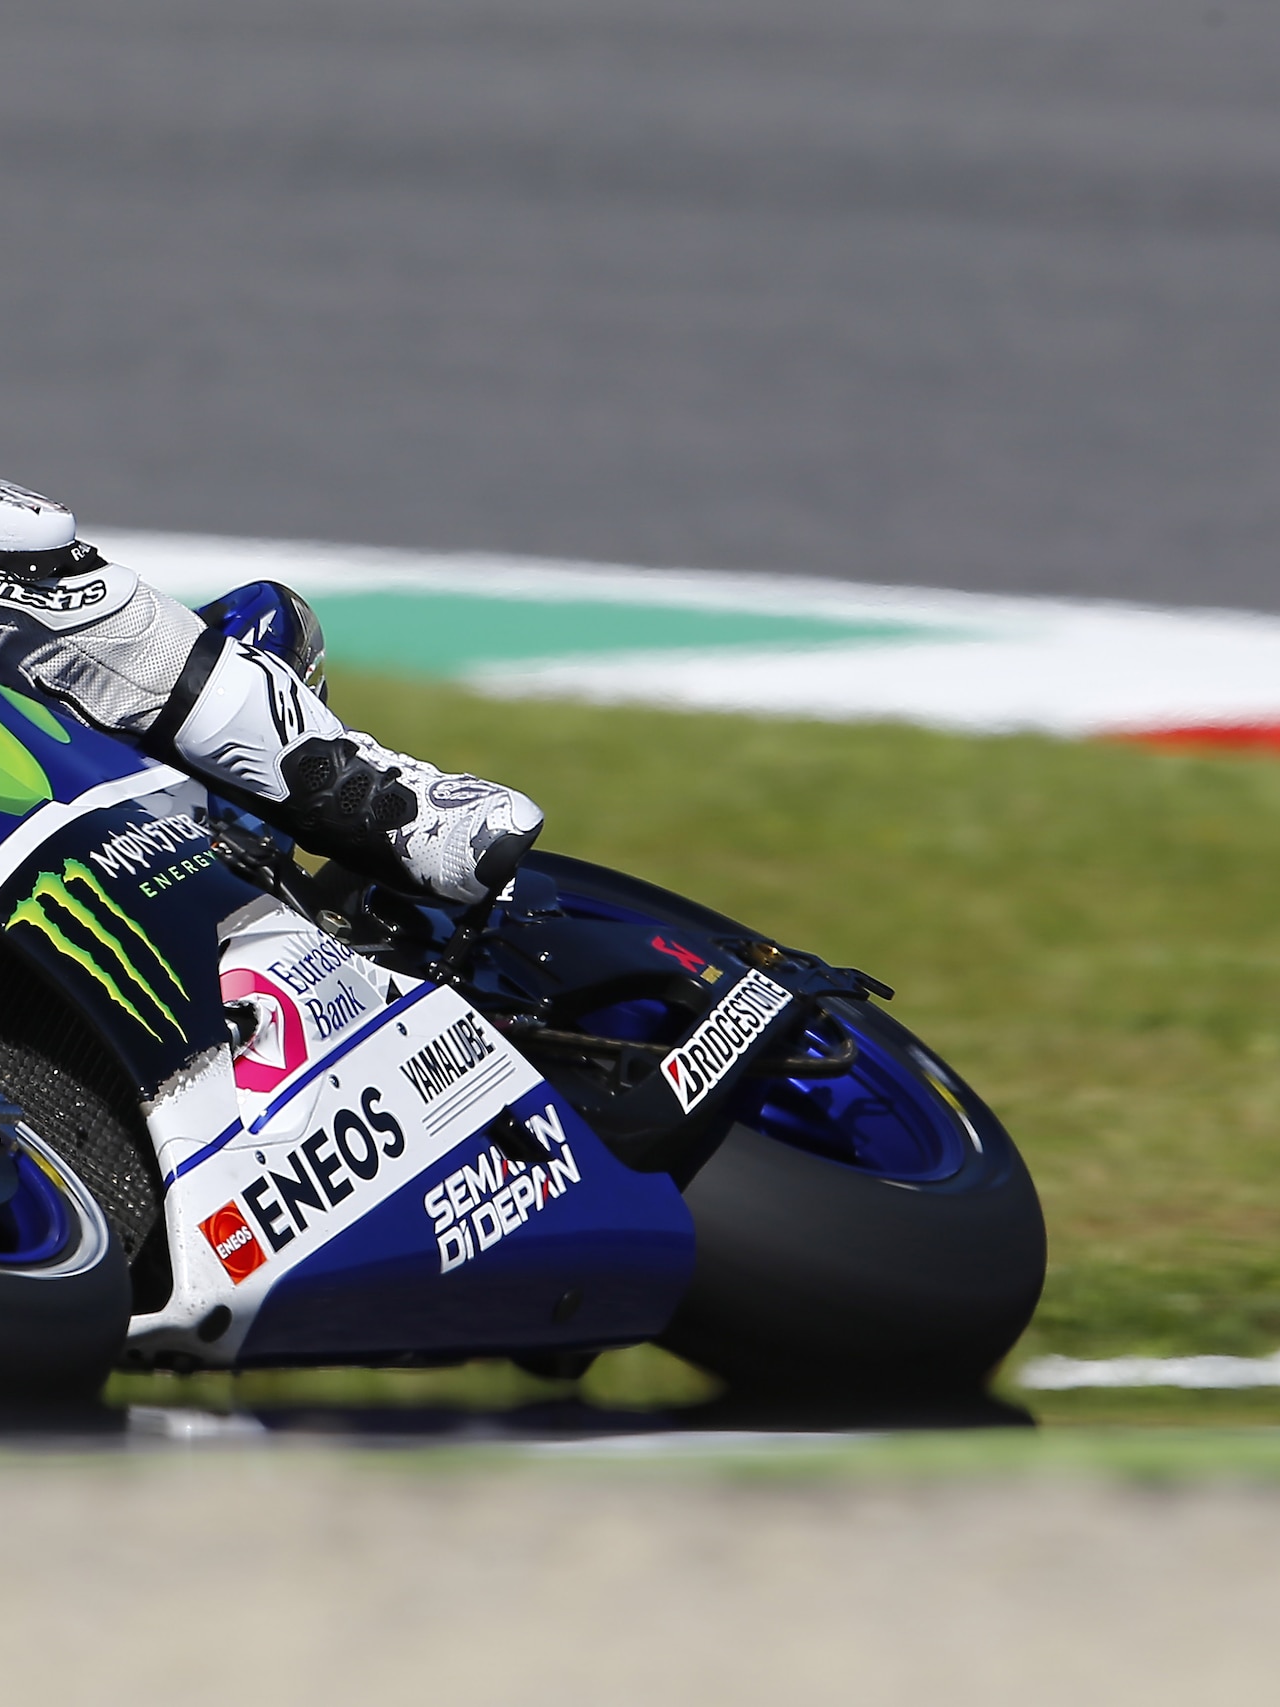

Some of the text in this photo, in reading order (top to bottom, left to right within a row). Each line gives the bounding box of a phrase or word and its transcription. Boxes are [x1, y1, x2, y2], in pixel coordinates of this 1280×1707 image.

[89, 814, 214, 879] MONSTER
[138, 850, 217, 898] ENERGY
[268, 930, 357, 996] Eurasia
[304, 979, 366, 1040] Bank
[661, 969, 792, 1114] BRIDGESTONE
[398, 1012, 495, 1104] YAMALUBE
[241, 1087, 405, 1252] ENEOS
[424, 1103, 566, 1235] SEMAN
[470, 1143, 582, 1252] DEPAN
[216, 1224, 253, 1261] ENEOS
